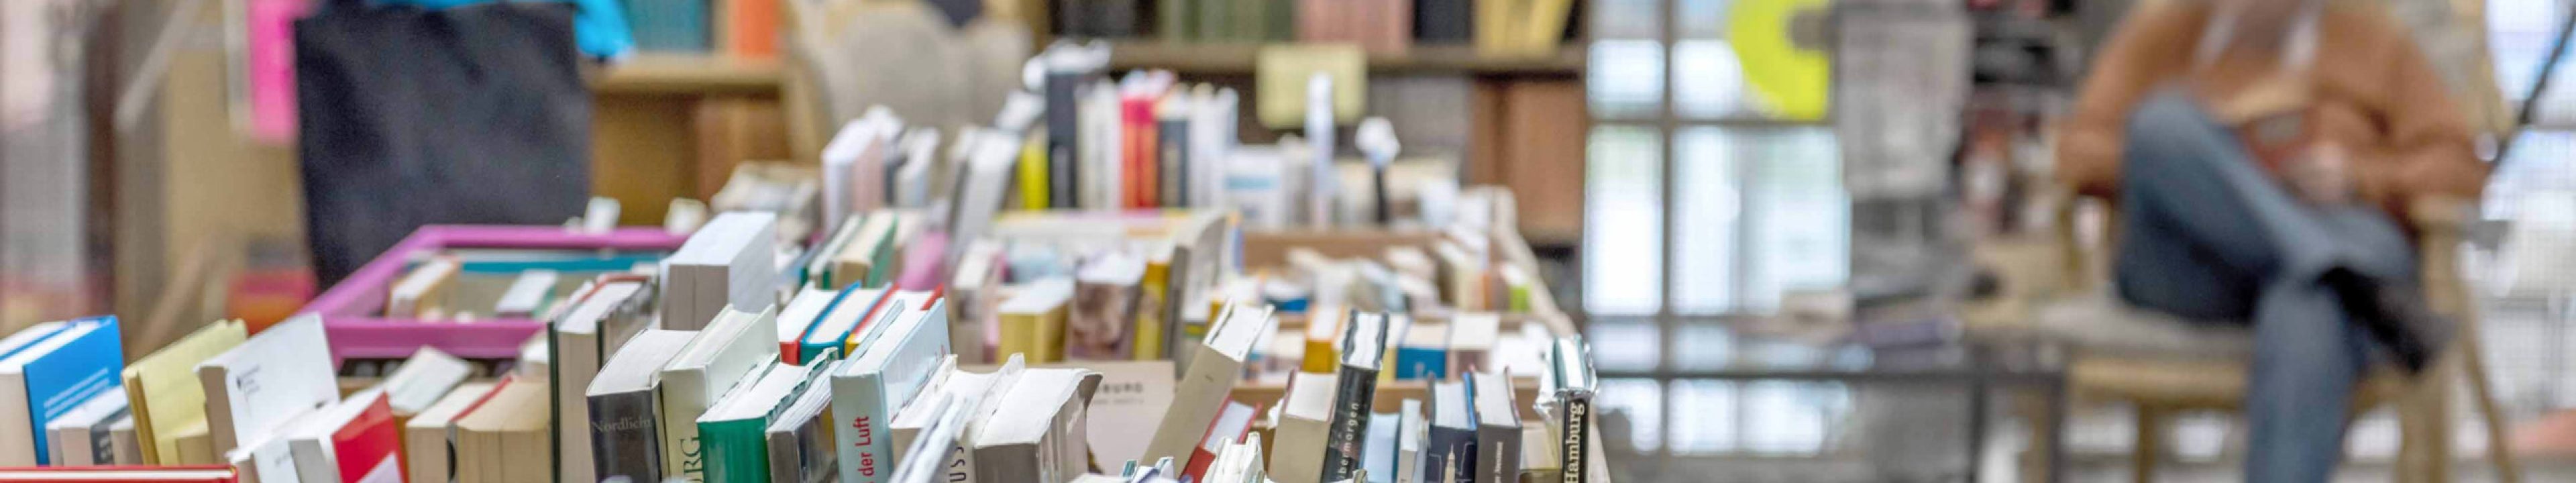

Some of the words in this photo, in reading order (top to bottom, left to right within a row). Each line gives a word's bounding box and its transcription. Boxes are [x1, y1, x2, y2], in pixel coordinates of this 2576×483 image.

[853, 416, 871, 447] Luft
[1564, 402, 1585, 483] Hamburg
[857, 451, 874, 477] der
